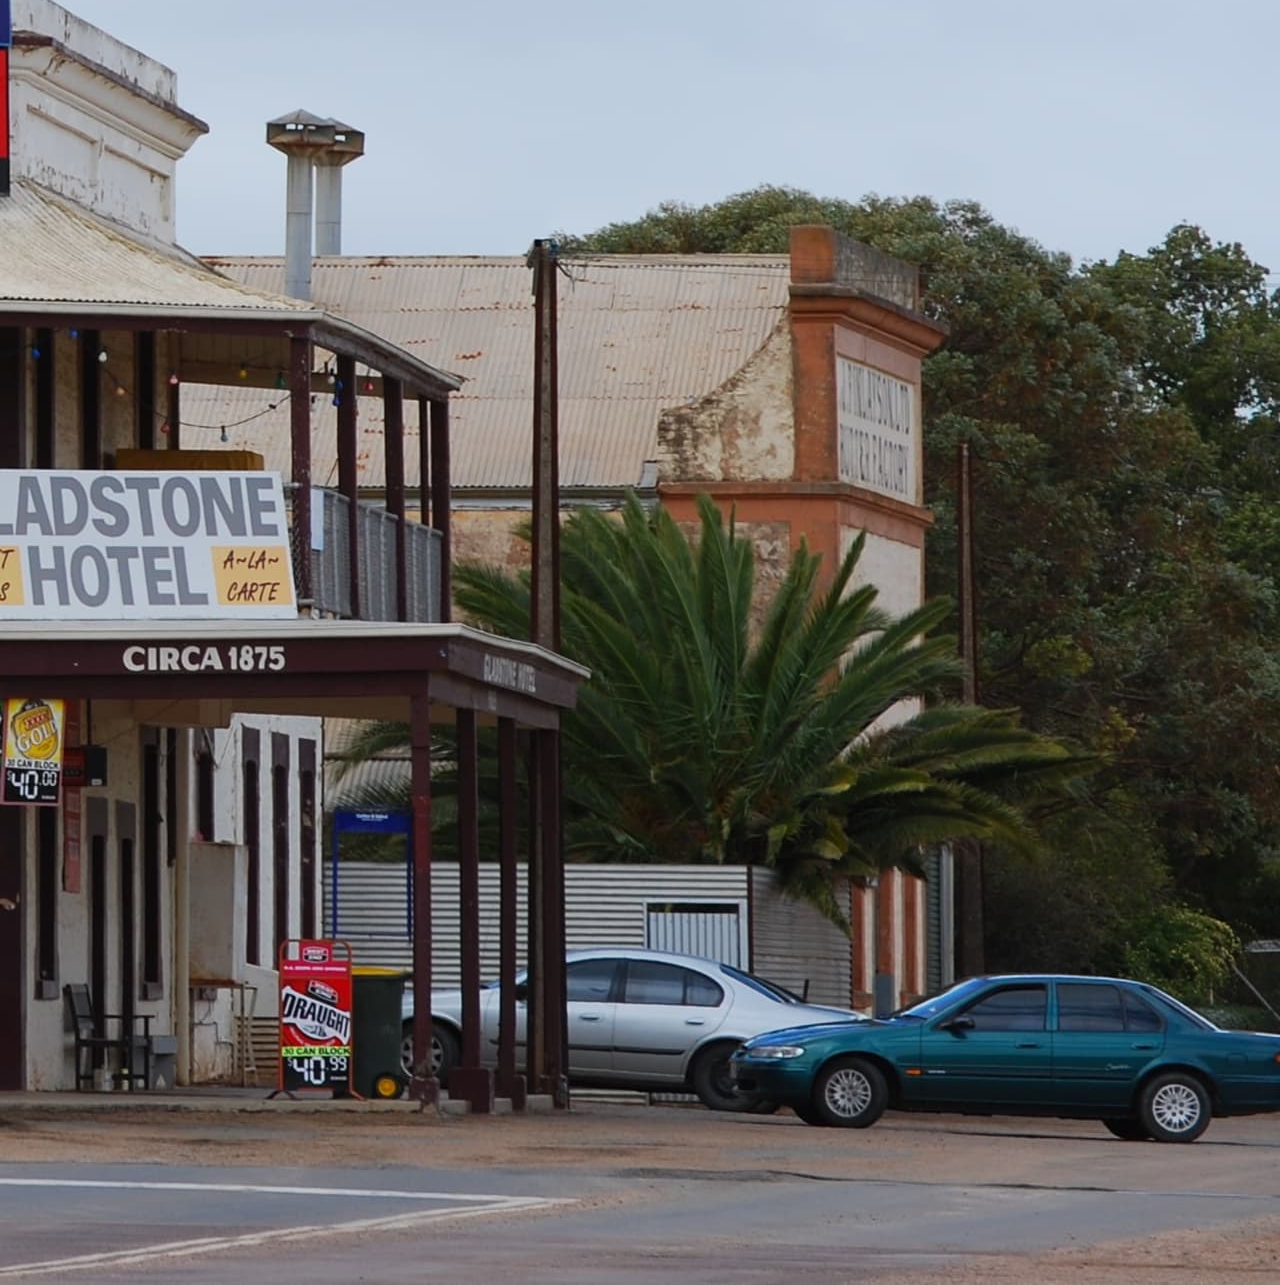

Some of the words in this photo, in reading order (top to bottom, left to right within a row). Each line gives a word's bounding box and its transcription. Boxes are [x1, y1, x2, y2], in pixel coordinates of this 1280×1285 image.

[27, 545, 209, 607] HOTEL
[227, 582, 281, 602] CARTE
[122, 646, 223, 671] CIRCA
[227, 646, 285, 671] 1875
[34, 761, 58, 769] BLOCK
[283, 993, 349, 1038] DRAUGHT
[296, 1047, 316, 1055] CAN
[318, 1047, 351, 1056] BLOCK
